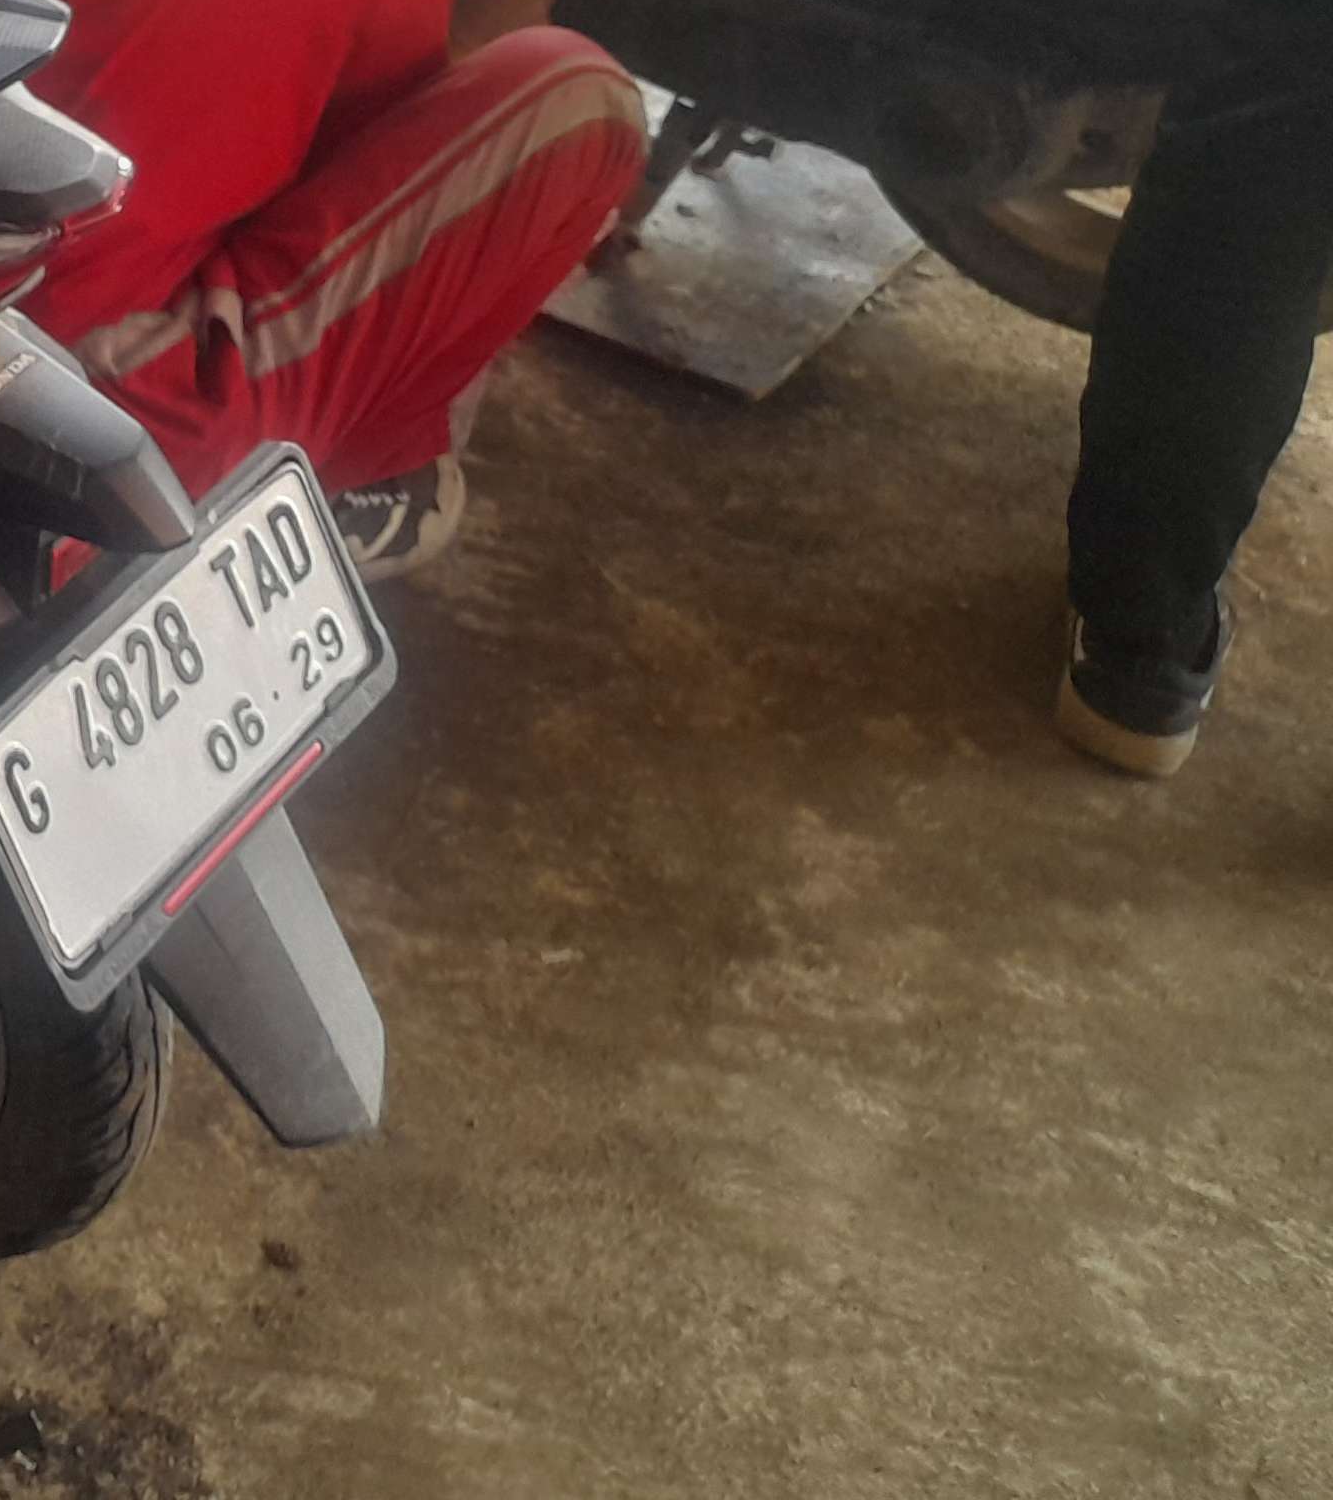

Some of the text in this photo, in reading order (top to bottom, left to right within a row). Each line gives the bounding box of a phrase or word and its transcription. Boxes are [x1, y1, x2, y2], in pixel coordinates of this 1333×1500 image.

[3, 500, 313, 835] G 4828 TAD
